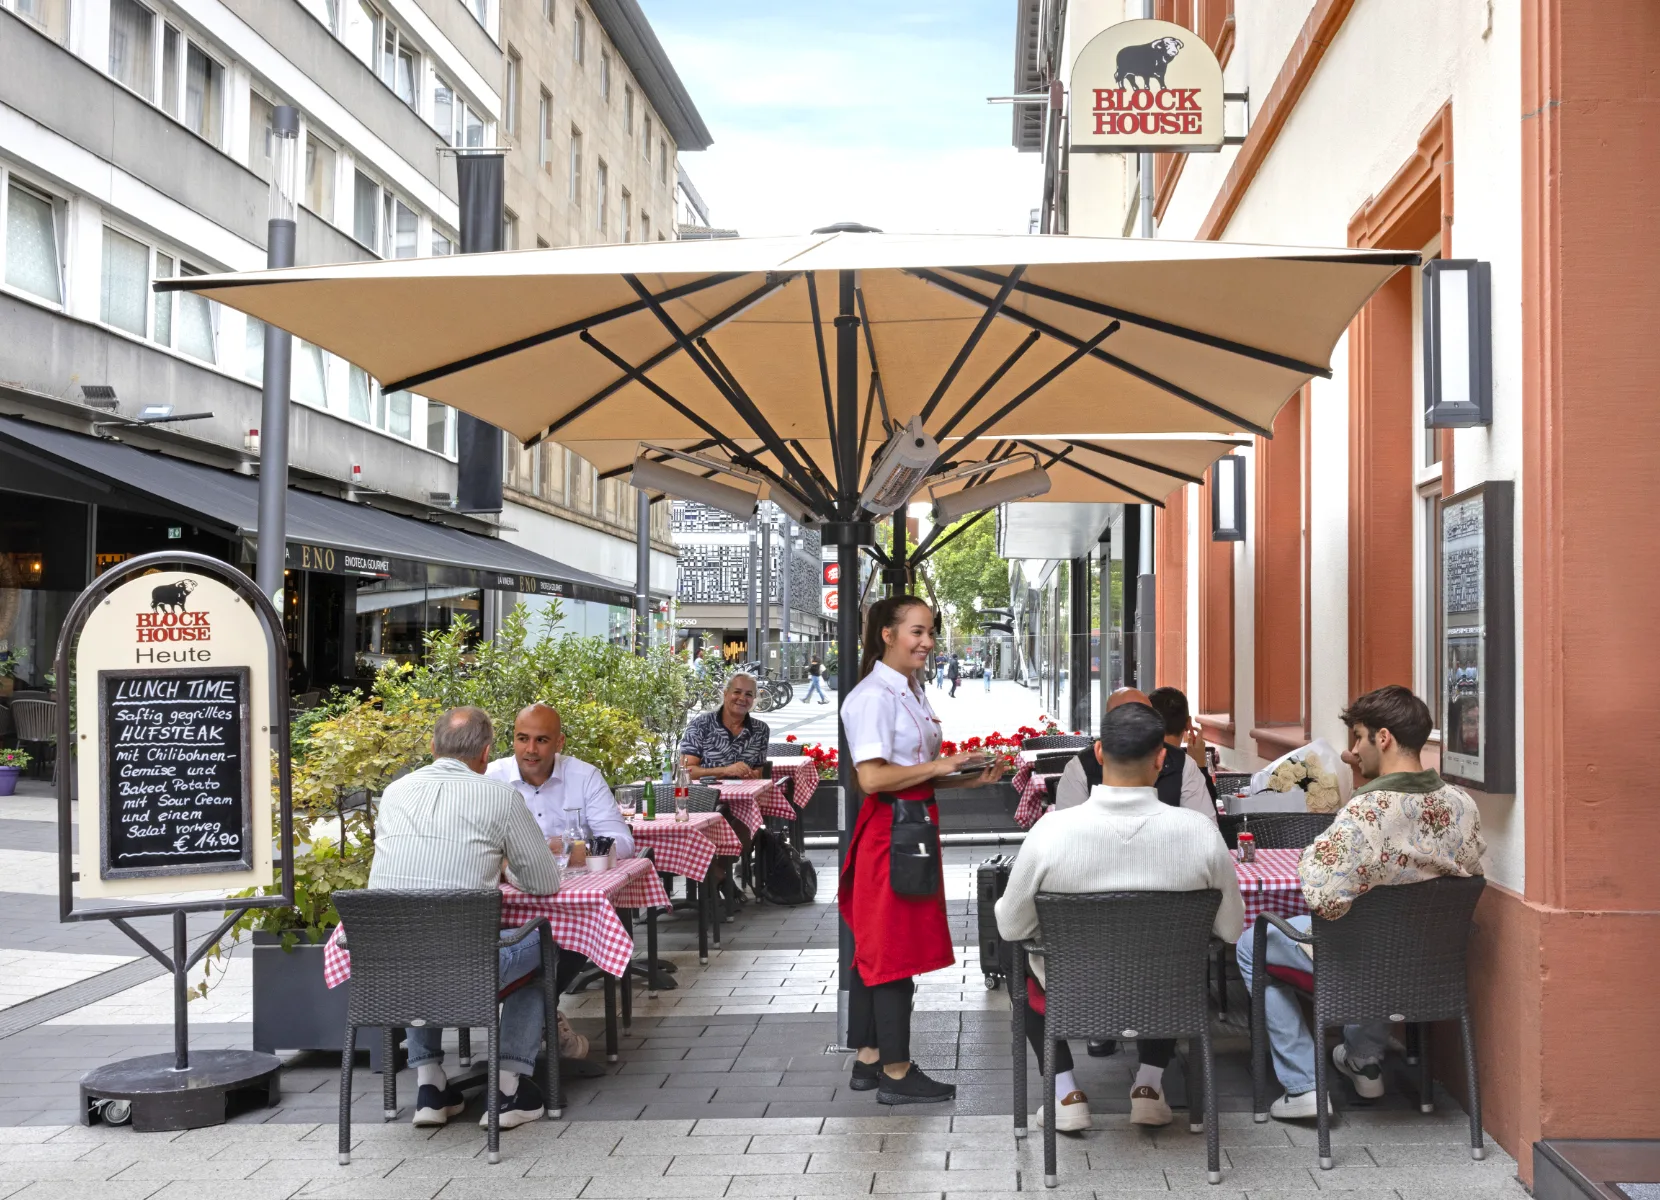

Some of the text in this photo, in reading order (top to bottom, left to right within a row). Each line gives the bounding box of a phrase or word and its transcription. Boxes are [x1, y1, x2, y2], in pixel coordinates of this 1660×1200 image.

[1092, 88, 1202, 111] BLOCK
[1092, 112, 1203, 135] HOUSE
[302, 544, 335, 571] ENO
[344, 555, 390, 571] ENOTECA GOURMET
[519, 575, 537, 593] ENO
[135, 611, 211, 628] BLOCK
[135, 627, 211, 643] HOUSE
[136, 647, 212, 664] Heute
[115, 680, 235, 700] LUNCH TIME
[115, 706, 233, 725] Saftig gegrilltes
[120, 725, 224, 741] HUFSTEAK
[116, 748, 140, 761] mit
[120, 764, 217, 778] Gemüse und
[118, 778, 220, 796] Baked Potato
[122, 792, 233, 810] mit Sour Cream
[121, 809, 203, 823] und einem
[126, 822, 221, 838] Salat vorweg
[173, 835, 190, 852] €
